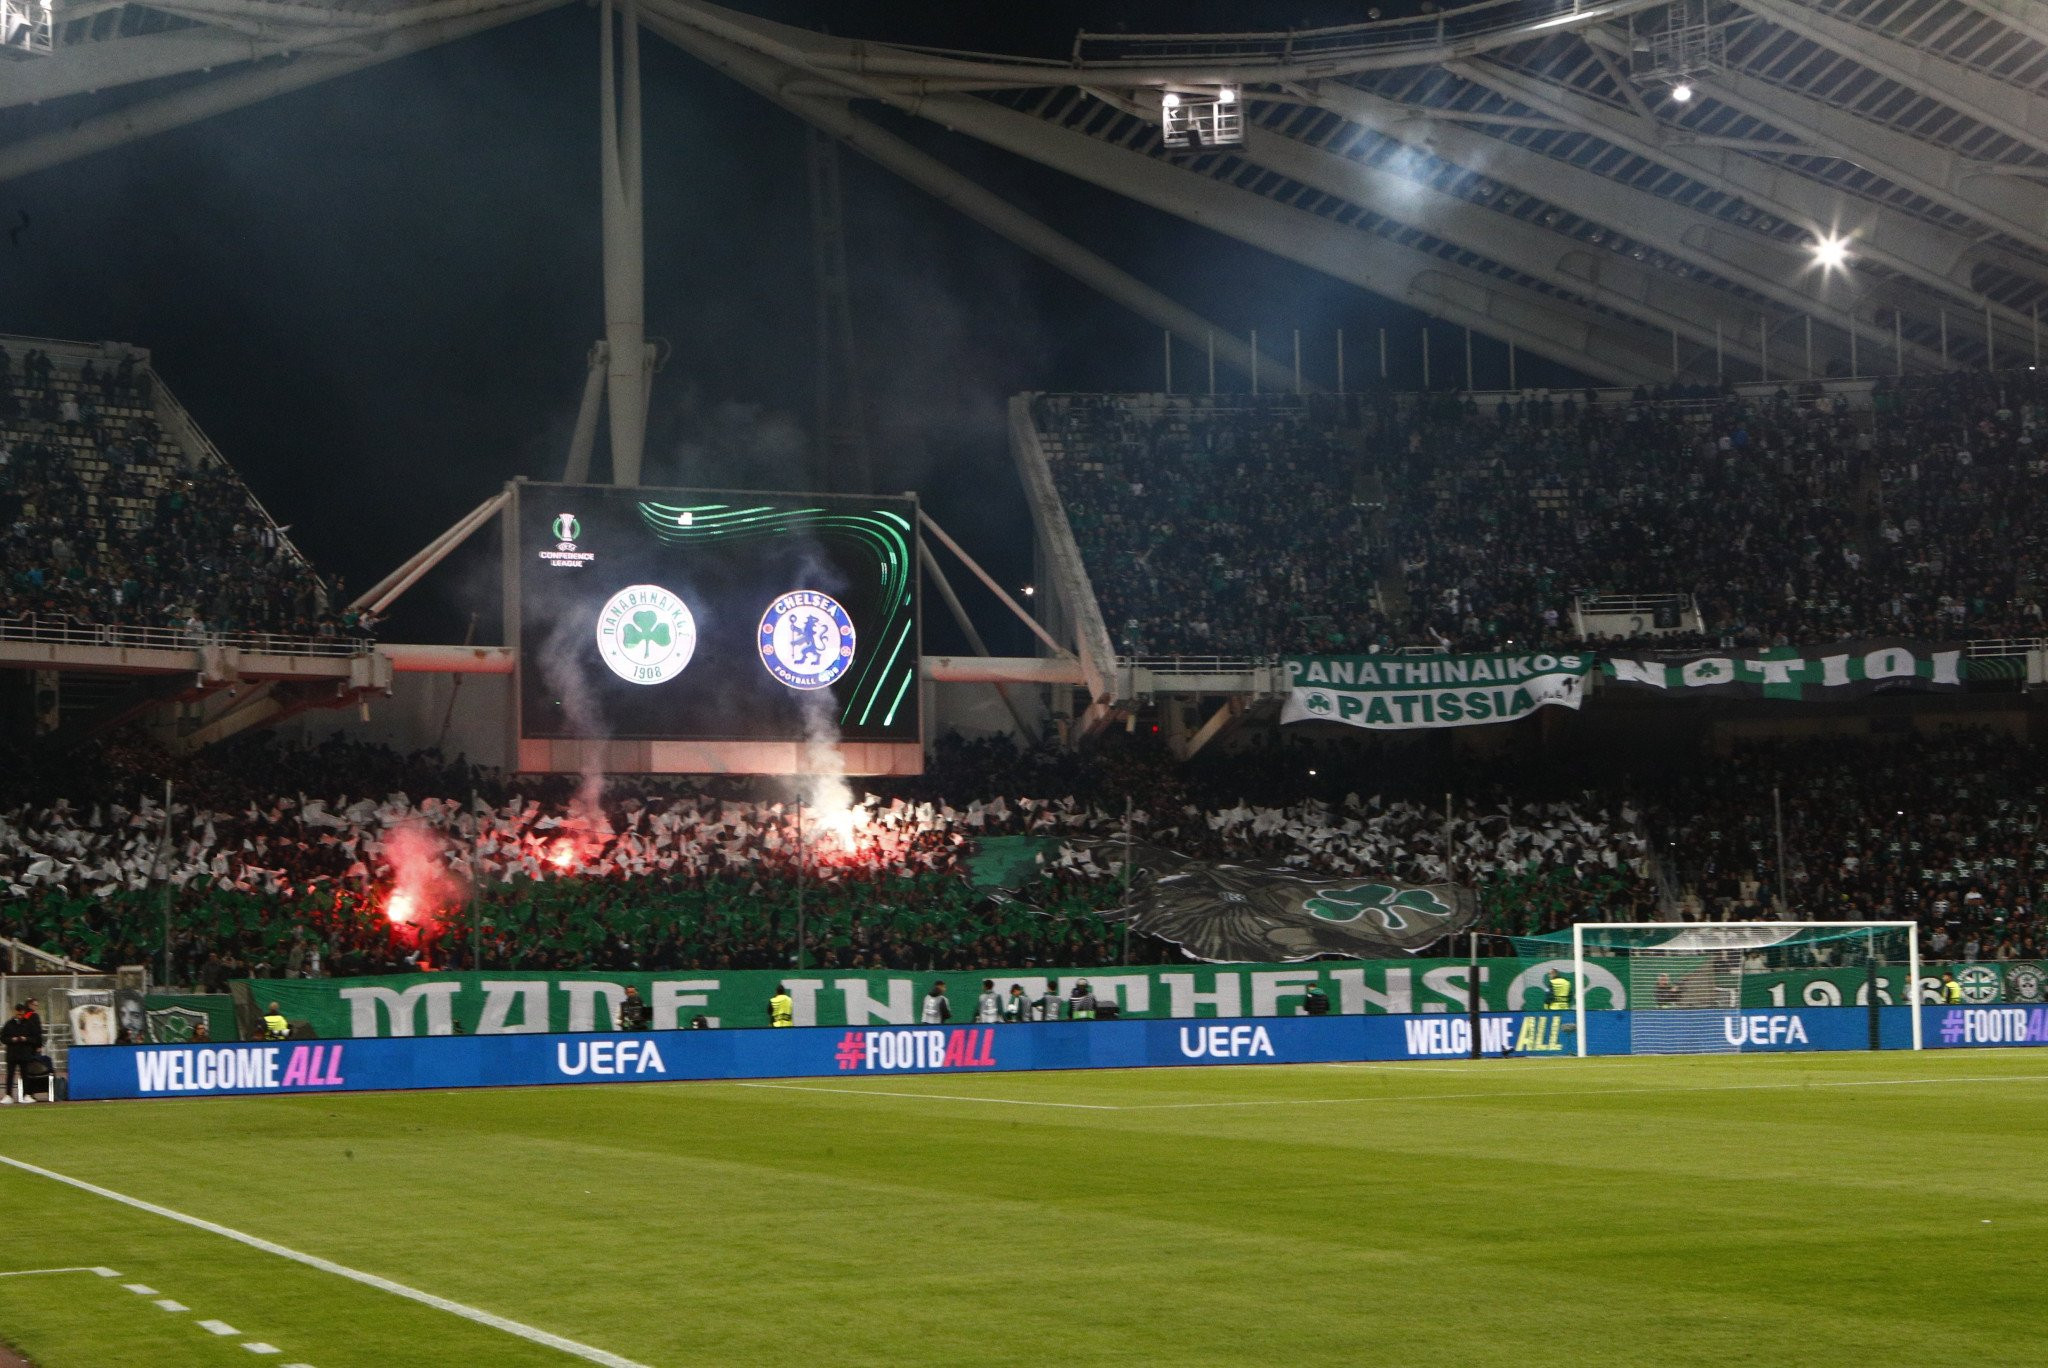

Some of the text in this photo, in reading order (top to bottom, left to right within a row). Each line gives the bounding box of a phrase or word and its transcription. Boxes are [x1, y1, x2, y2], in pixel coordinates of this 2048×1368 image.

[775, 593, 838, 617] CHELSEA
[633, 666, 662, 679] 1908
[775, 665, 816, 685] FOOTBALL
[1283, 654, 1582, 685] PANATHINAIKOS
[1338, 687, 1536, 724] PATISSIA
[339, 980, 720, 1037] MADE
[780, 979, 915, 1027] IN
[1179, 1025, 1275, 1057] UEFA
[1515, 1016, 1562, 1051] ALL
[1724, 1015, 1808, 1045] UEFA
[557, 1040, 666, 1075] UEFA
[834, 1029, 996, 1070] #FOOTBALL
[136, 1045, 344, 1091] WELCOME ALL
